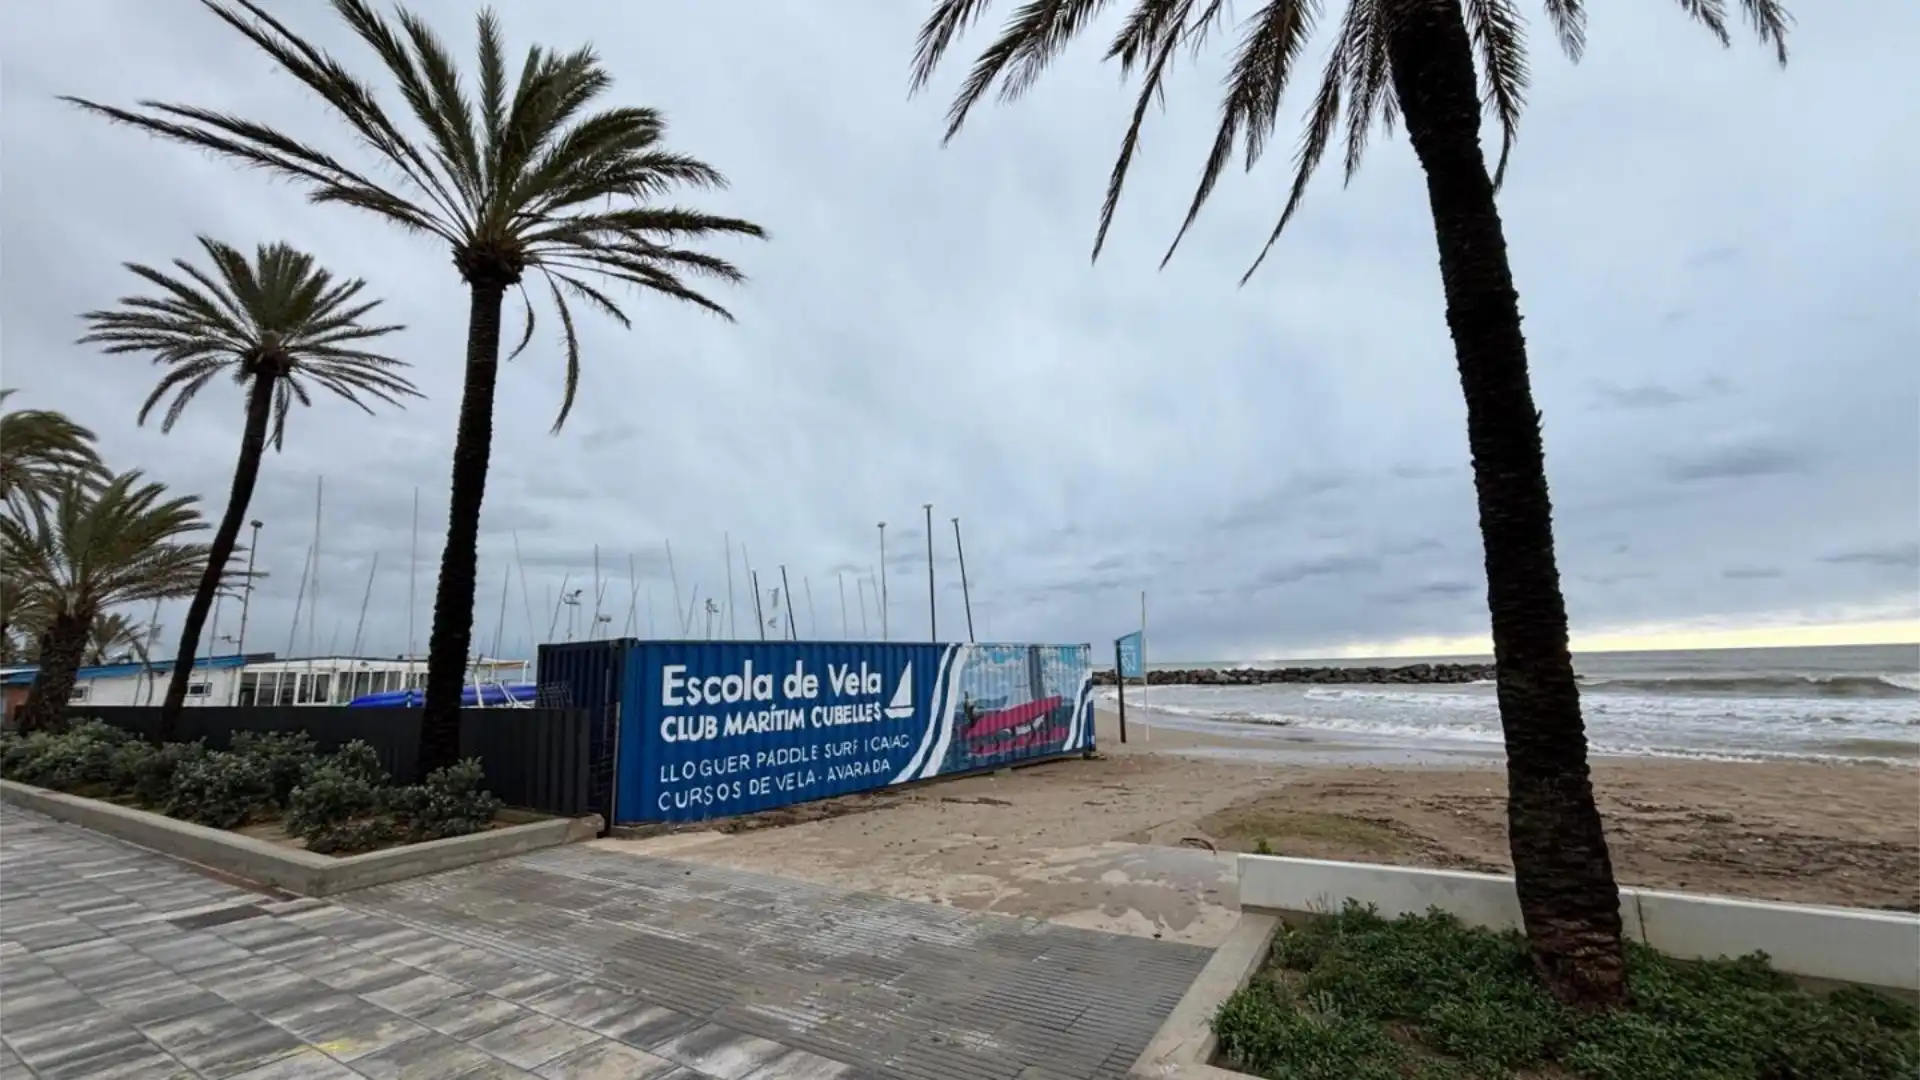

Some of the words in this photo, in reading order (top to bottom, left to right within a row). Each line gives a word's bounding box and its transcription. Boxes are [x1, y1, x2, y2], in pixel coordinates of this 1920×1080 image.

[662, 659, 773, 706] Escola
[783, 659, 818, 699] de
[828, 661, 882, 698] Vela
[660, 715, 719, 743] CLUB
[723, 704, 805, 737] MARÍTIM
[811, 702, 882, 728] CUBELLES
[660, 753, 751, 783] LLOGUER
[756, 745, 818, 769] PADDLE
[824, 739, 859, 759] SURF
[870, 733, 910, 752] CAIAC
[658, 780, 741, 812] CURSOS
[749, 776, 771, 796] DE
[775, 769, 816, 792] VELA
[827, 758, 891, 784] AVARADA
